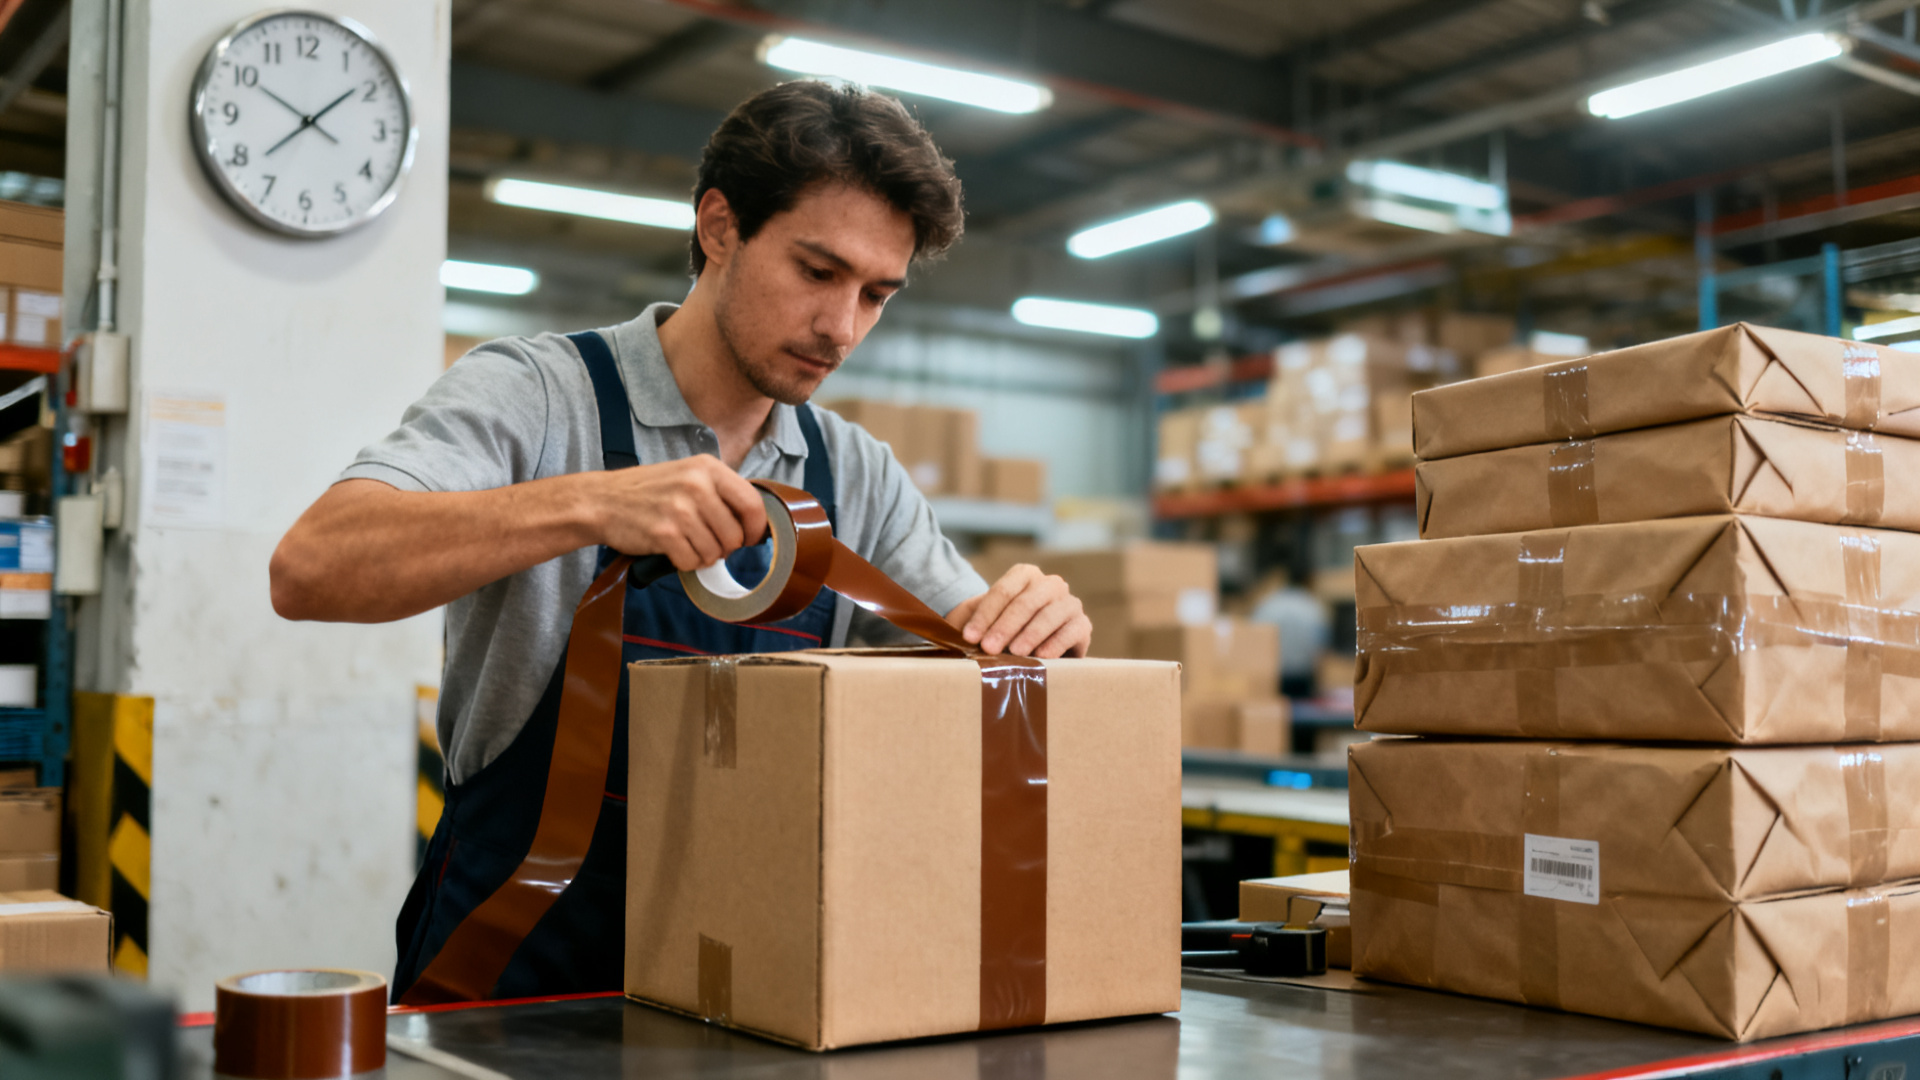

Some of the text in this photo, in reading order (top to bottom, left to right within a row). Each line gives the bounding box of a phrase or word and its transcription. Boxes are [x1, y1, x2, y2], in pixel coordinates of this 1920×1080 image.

[264, 42, 281, 64] 11
[296, 35, 320, 59] 12
[342, 50, 349, 73] 1
[234, 65, 258, 86] 10
[361, 80, 377, 102] 2
[222, 102, 239, 125] 9
[373, 120, 386, 142] 3
[233, 144, 248, 167] 8
[262, 175, 276, 200] 7
[333, 182, 347, 203] 5
[298, 190, 312, 211] 6
